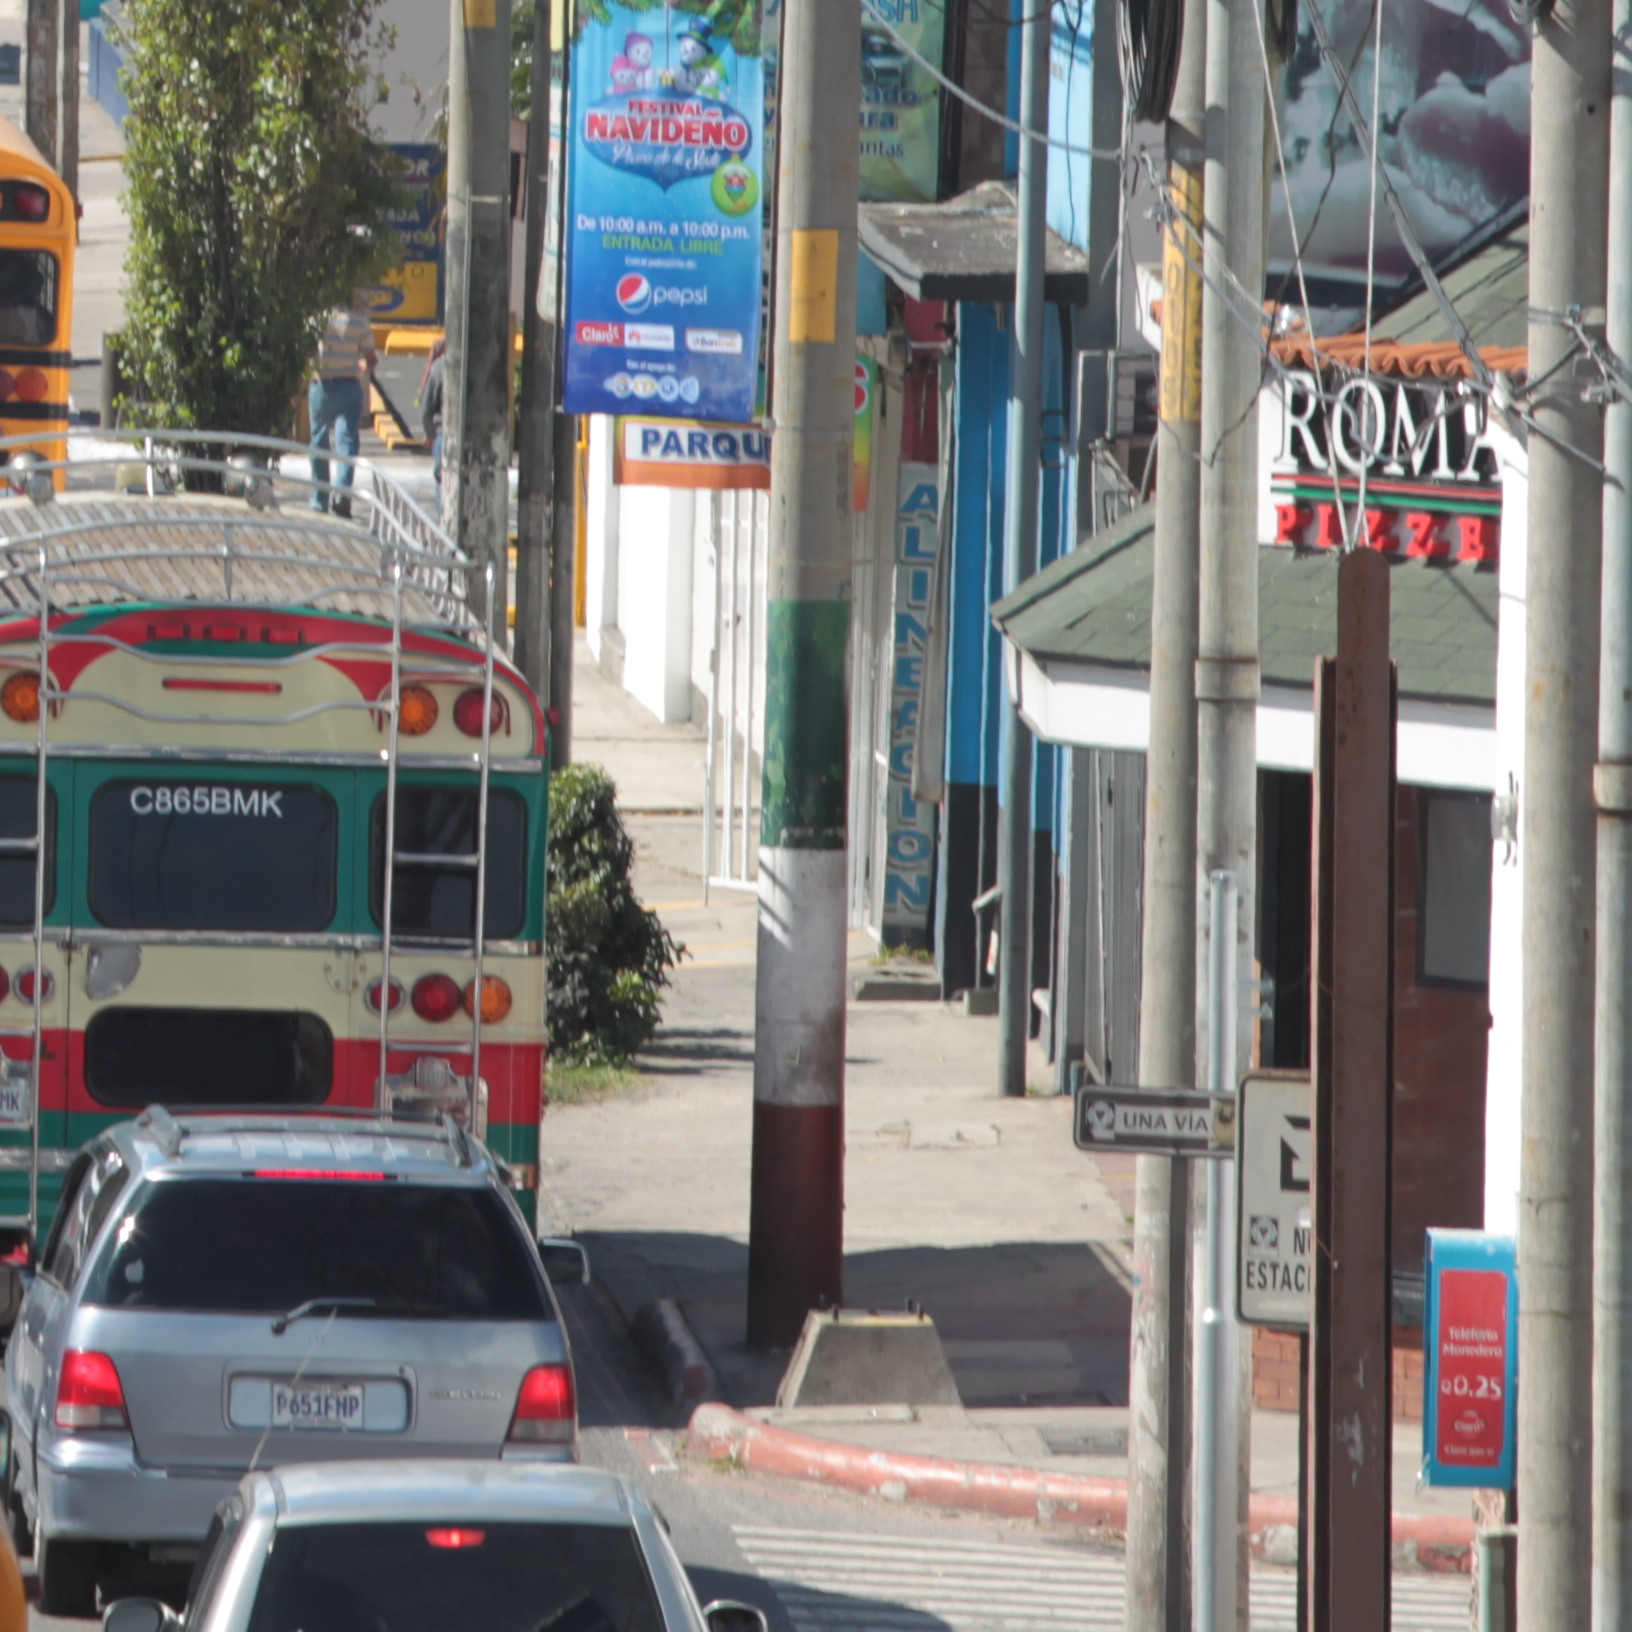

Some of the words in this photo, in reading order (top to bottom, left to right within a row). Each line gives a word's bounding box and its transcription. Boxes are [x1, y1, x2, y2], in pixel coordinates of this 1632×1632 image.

[628, 99, 703, 118] FESTIVAL
[586, 110, 749, 148] NAVIDEÑO
[577, 215, 596, 232] De
[599, 215, 635, 235] 10:00
[635, 220, 667, 236] a.m.
[681, 219, 719, 238] 10:00
[602, 233, 674, 253] ENTRADA
[679, 236, 725, 256] LIBRE
[651, 285, 709, 308] pepsi
[129, 786, 284, 819] C865BMK
[1122, 1111, 1168, 1131] UNA
[1174, 1109, 1209, 1132] VÍA
